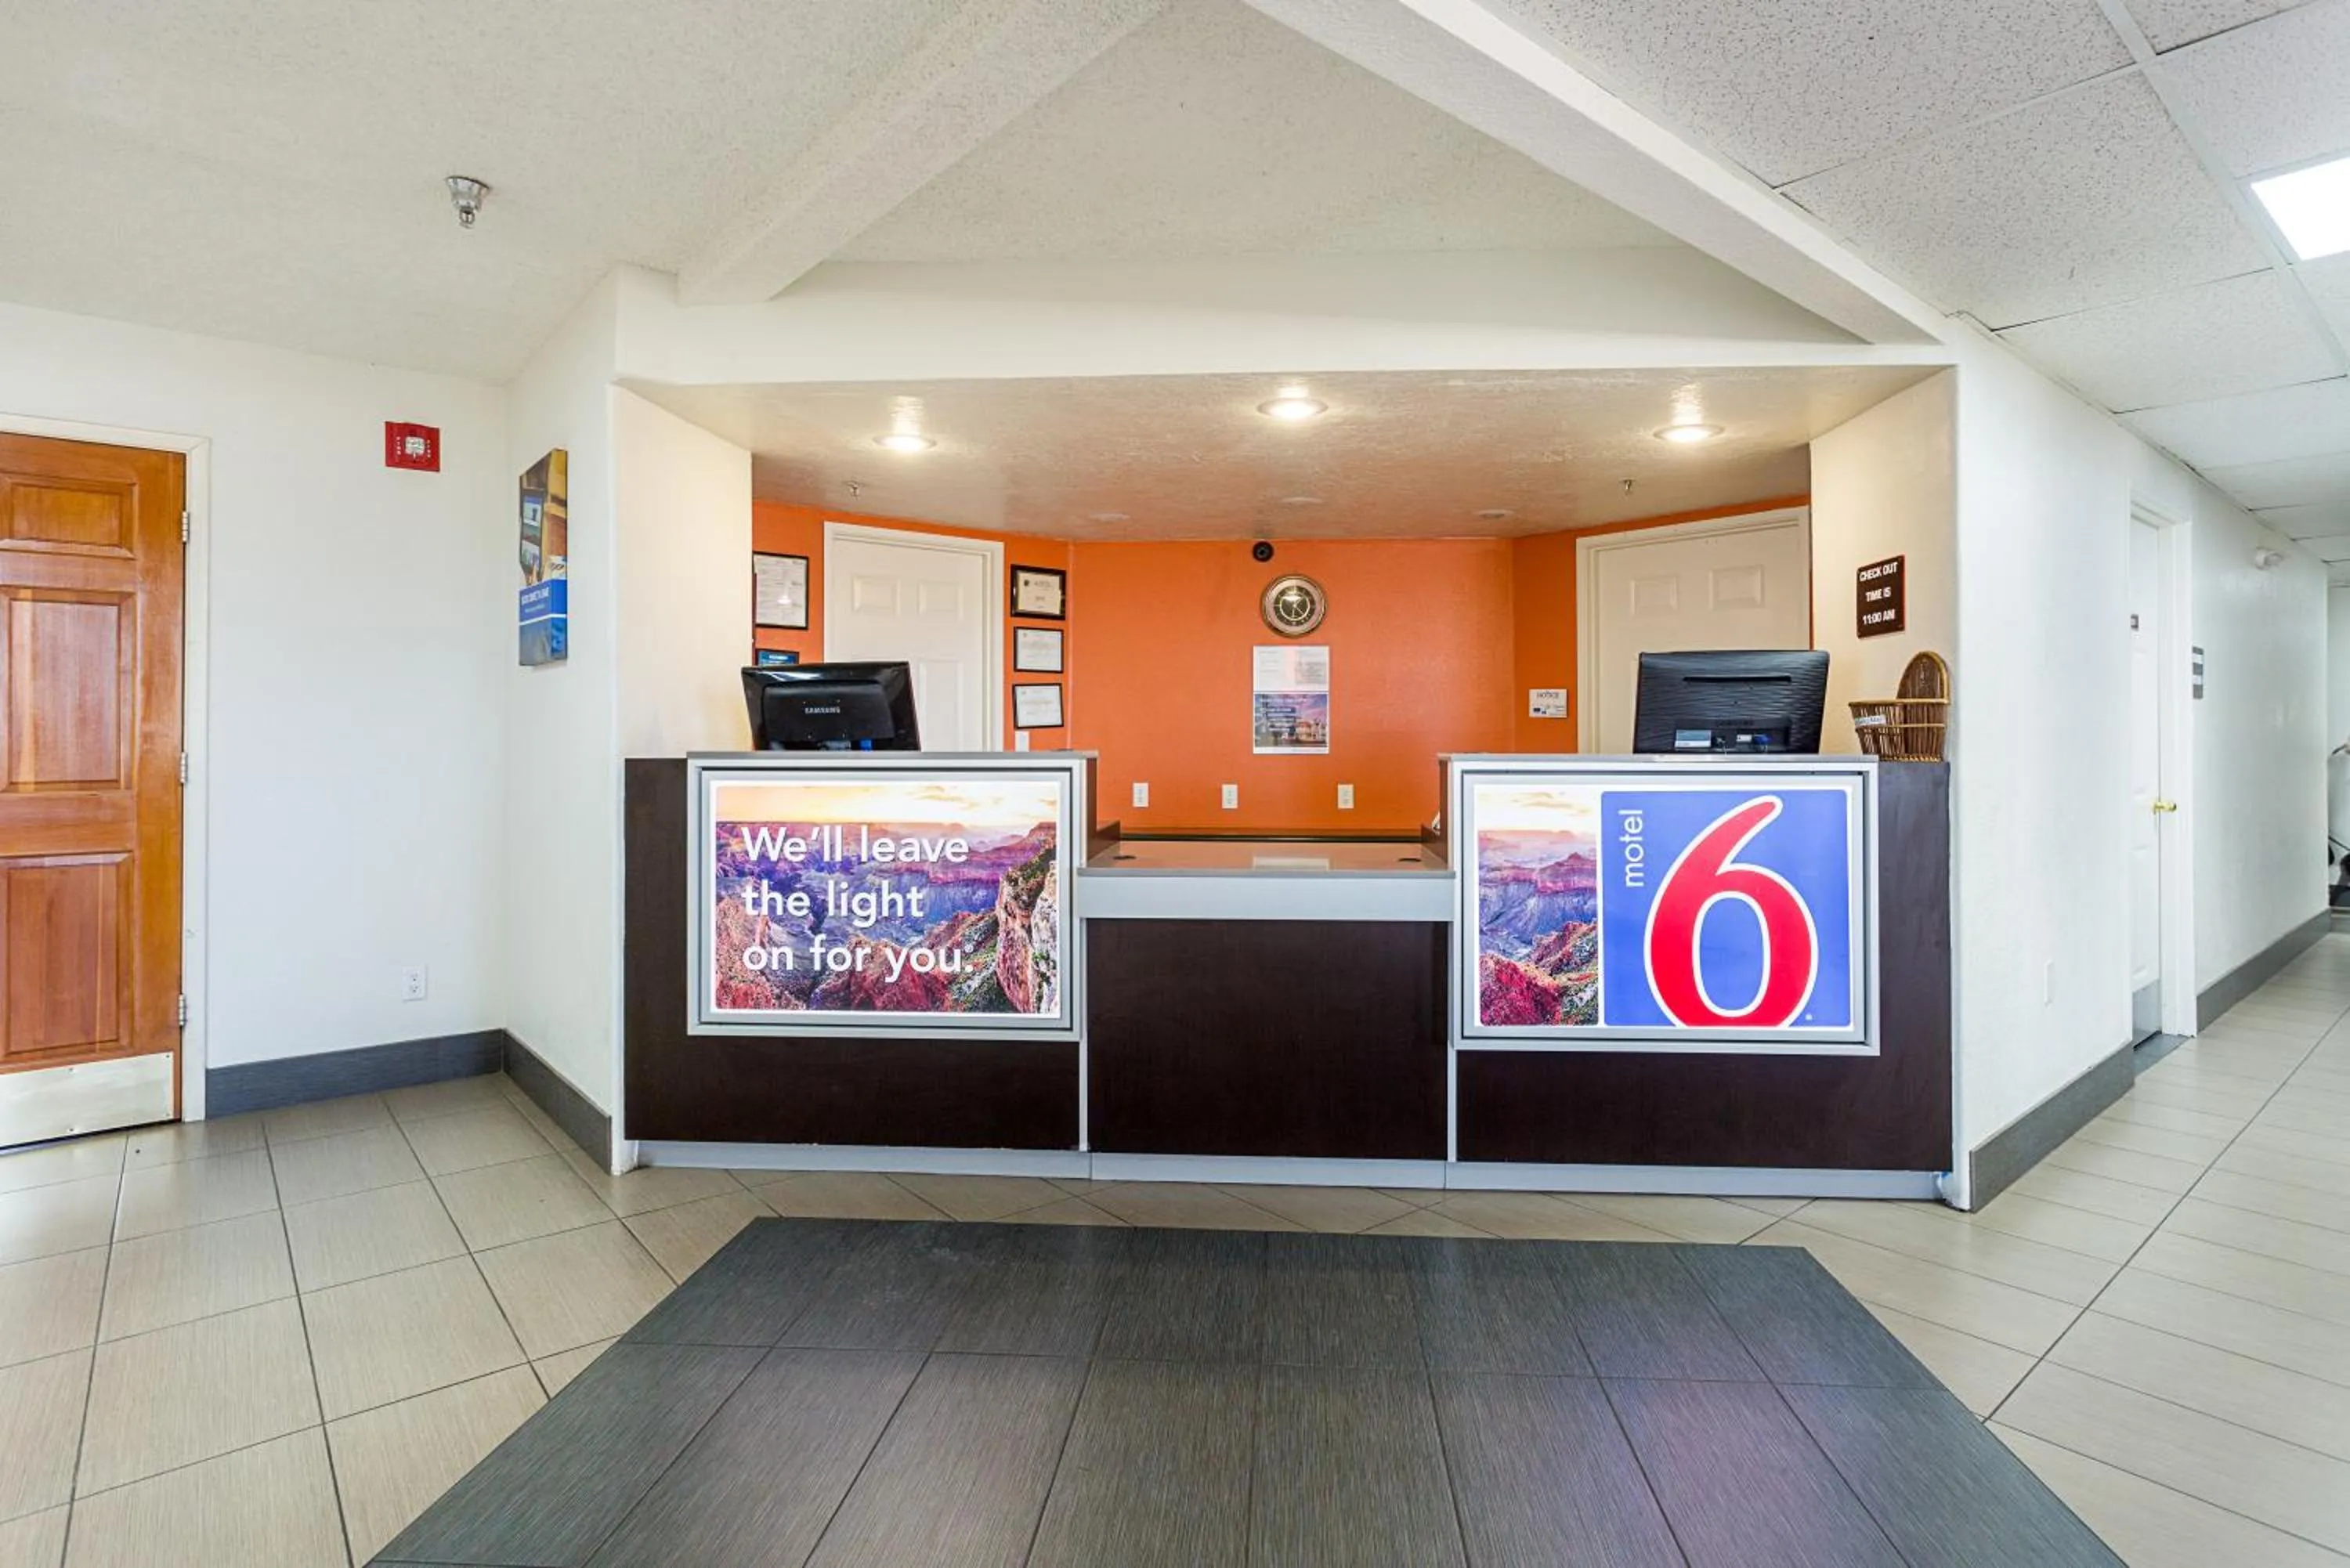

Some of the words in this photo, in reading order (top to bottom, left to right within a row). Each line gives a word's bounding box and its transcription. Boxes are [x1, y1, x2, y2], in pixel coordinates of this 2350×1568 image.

[1860, 567, 1882, 581] CHECK
[1882, 562, 1898, 576] OUT
[1865, 589, 1882, 602] TIME
[1883, 587, 1891, 598] IS
[1863, 612, 1882, 625] 11:00
[1882, 609, 1895, 621] AM
[741, 826, 843, 862] We'll
[860, 826, 970, 862] leave
[741, 880, 810, 917] the
[828, 880, 924, 928] light
[1618, 808, 1644, 887] motel
[1644, 794, 1819, 1028] 6
[743, 945, 794, 971] on
[809, 934, 871, 972] for
